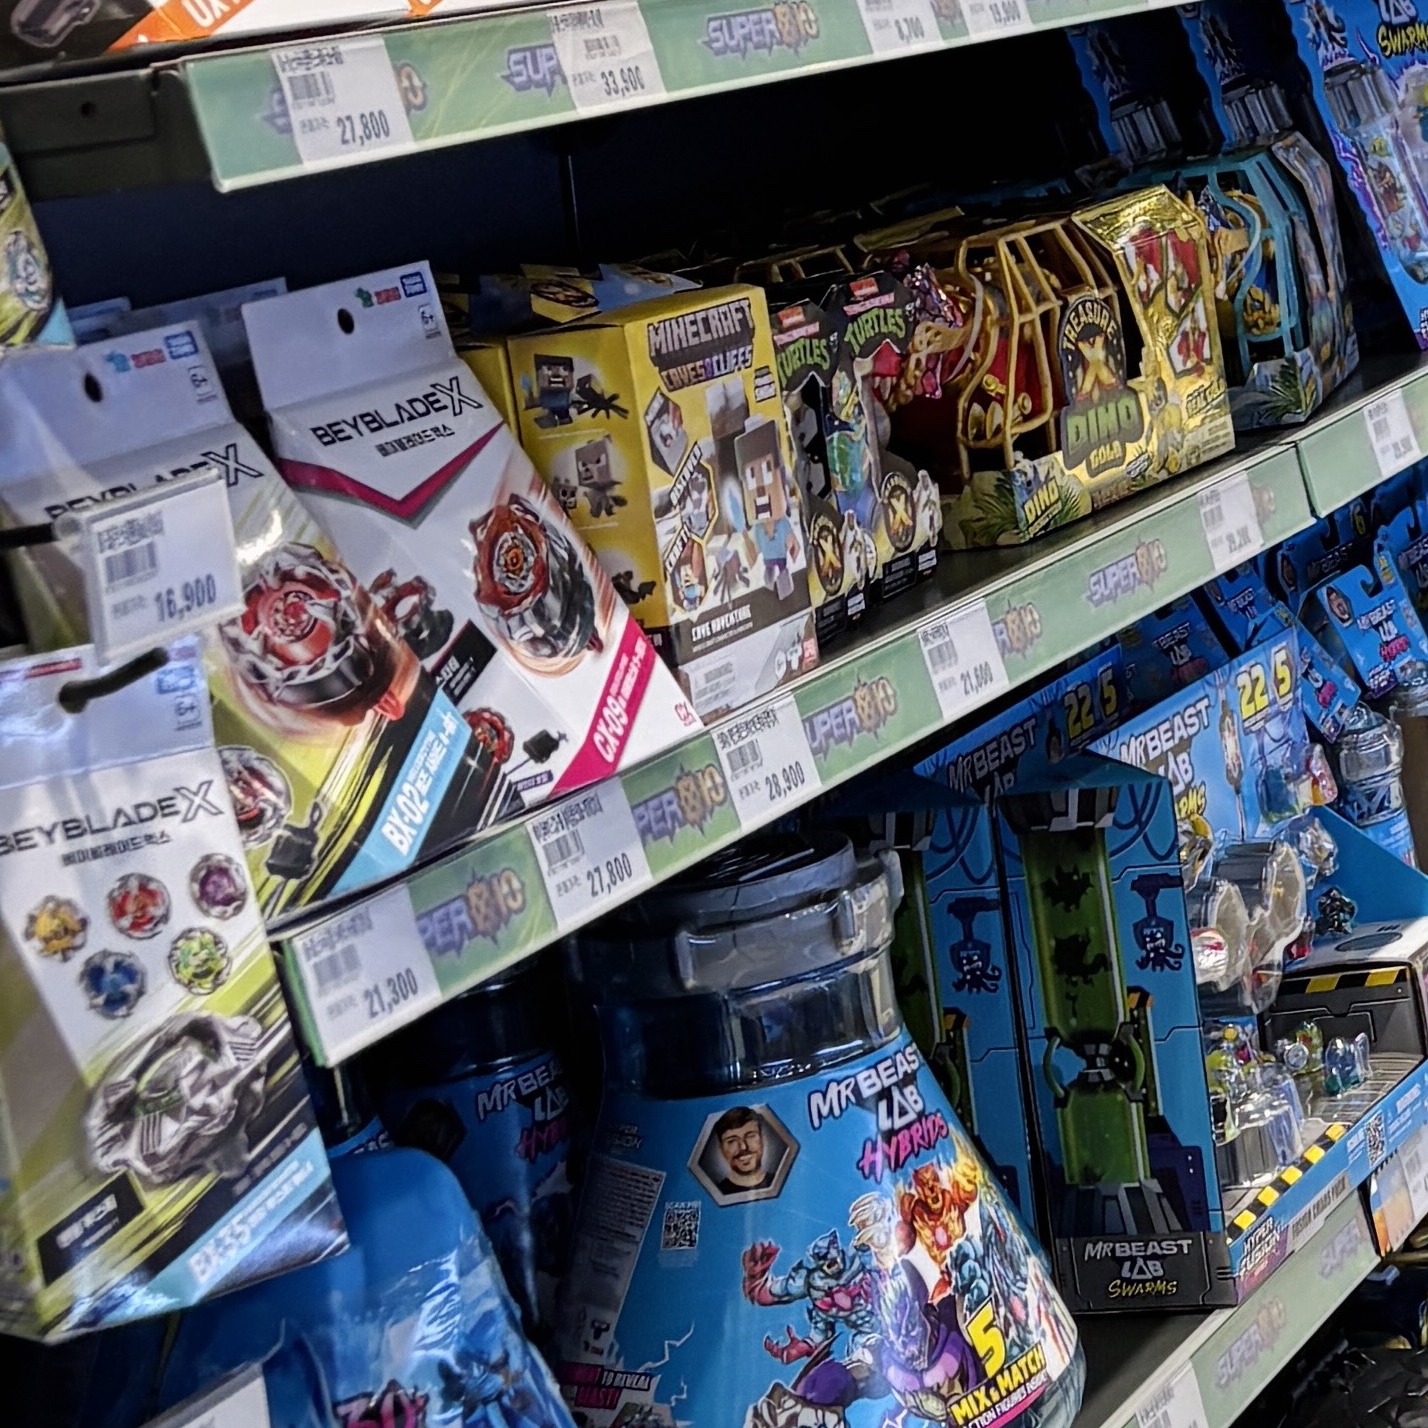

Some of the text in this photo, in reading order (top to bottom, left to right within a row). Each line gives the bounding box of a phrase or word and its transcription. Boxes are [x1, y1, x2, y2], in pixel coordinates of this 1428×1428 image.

[336, 110, 391, 147] 27,800
[647, 297, 755, 357] MINECRAFT
[843, 308, 907, 356] TURTLES
[1062, 298, 1118, 352] TREASURE
[1065, 395, 1140, 454] DINO
[1023, 479, 1060, 523] DINO
[154, 573, 218, 623] 16,900
[1064, 667, 1119, 742] 22 5
[1237, 642, 1295, 721] 22 5
[585, 851, 634, 899] 27,800
[364, 967, 419, 1017] 21,300
[876, 1085, 924, 1129] LAB
[858, 1112, 949, 1182] HYBRIDS
[1107, 1280, 1179, 1300] SWARMS
[1120, 1256, 1164, 1280] LAB
[966, 1298, 1008, 1378] 5
[950, 1385, 989, 1427] MIX
[998, 1345, 1047, 1393] MATCH
